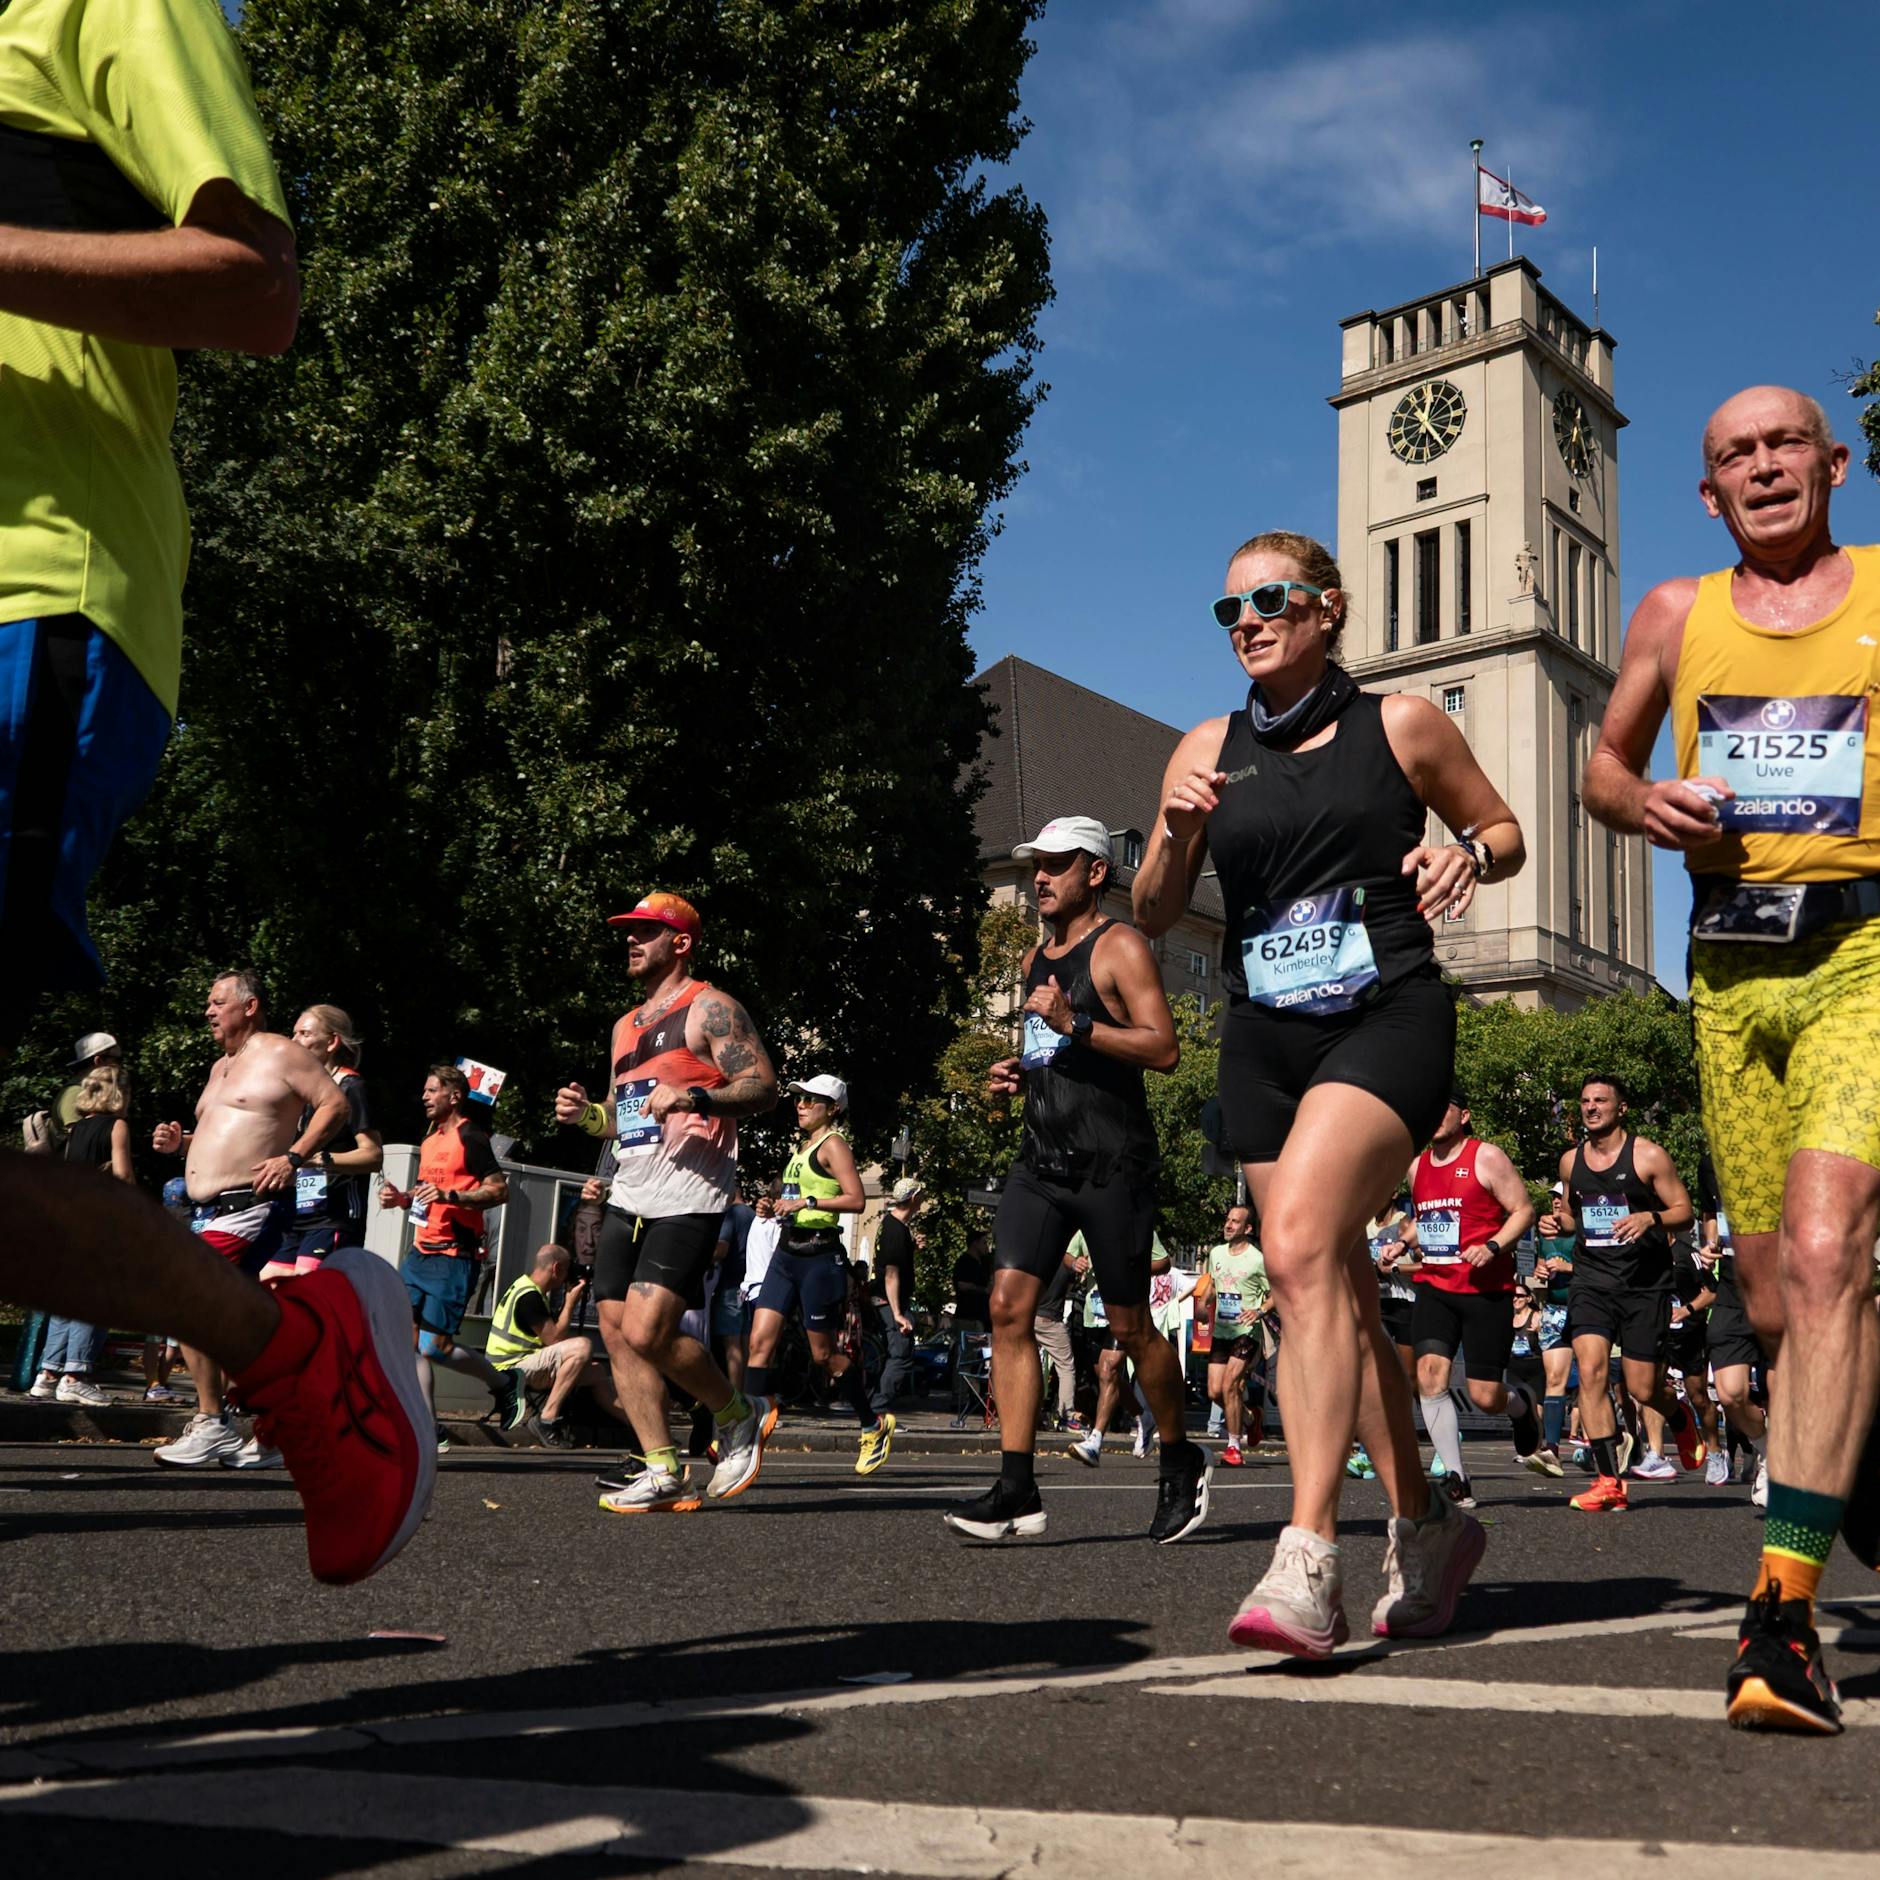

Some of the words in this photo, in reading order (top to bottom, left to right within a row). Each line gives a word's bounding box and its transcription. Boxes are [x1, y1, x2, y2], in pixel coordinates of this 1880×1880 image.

[1727, 734, 1828, 760] 21525
[1228, 764, 1258, 783] OKA
[1756, 763, 1794, 777] Uwe
[1734, 797, 1816, 815] zalando
[1260, 925, 1342, 961] 62499
[1273, 953, 1335, 975] Kimberley
[1275, 983, 1344, 1008] zalando
[1417, 1198, 1463, 1212] DENMARK
[1590, 1207, 1620, 1217] 56124
[1421, 1223, 1450, 1233] 16807
